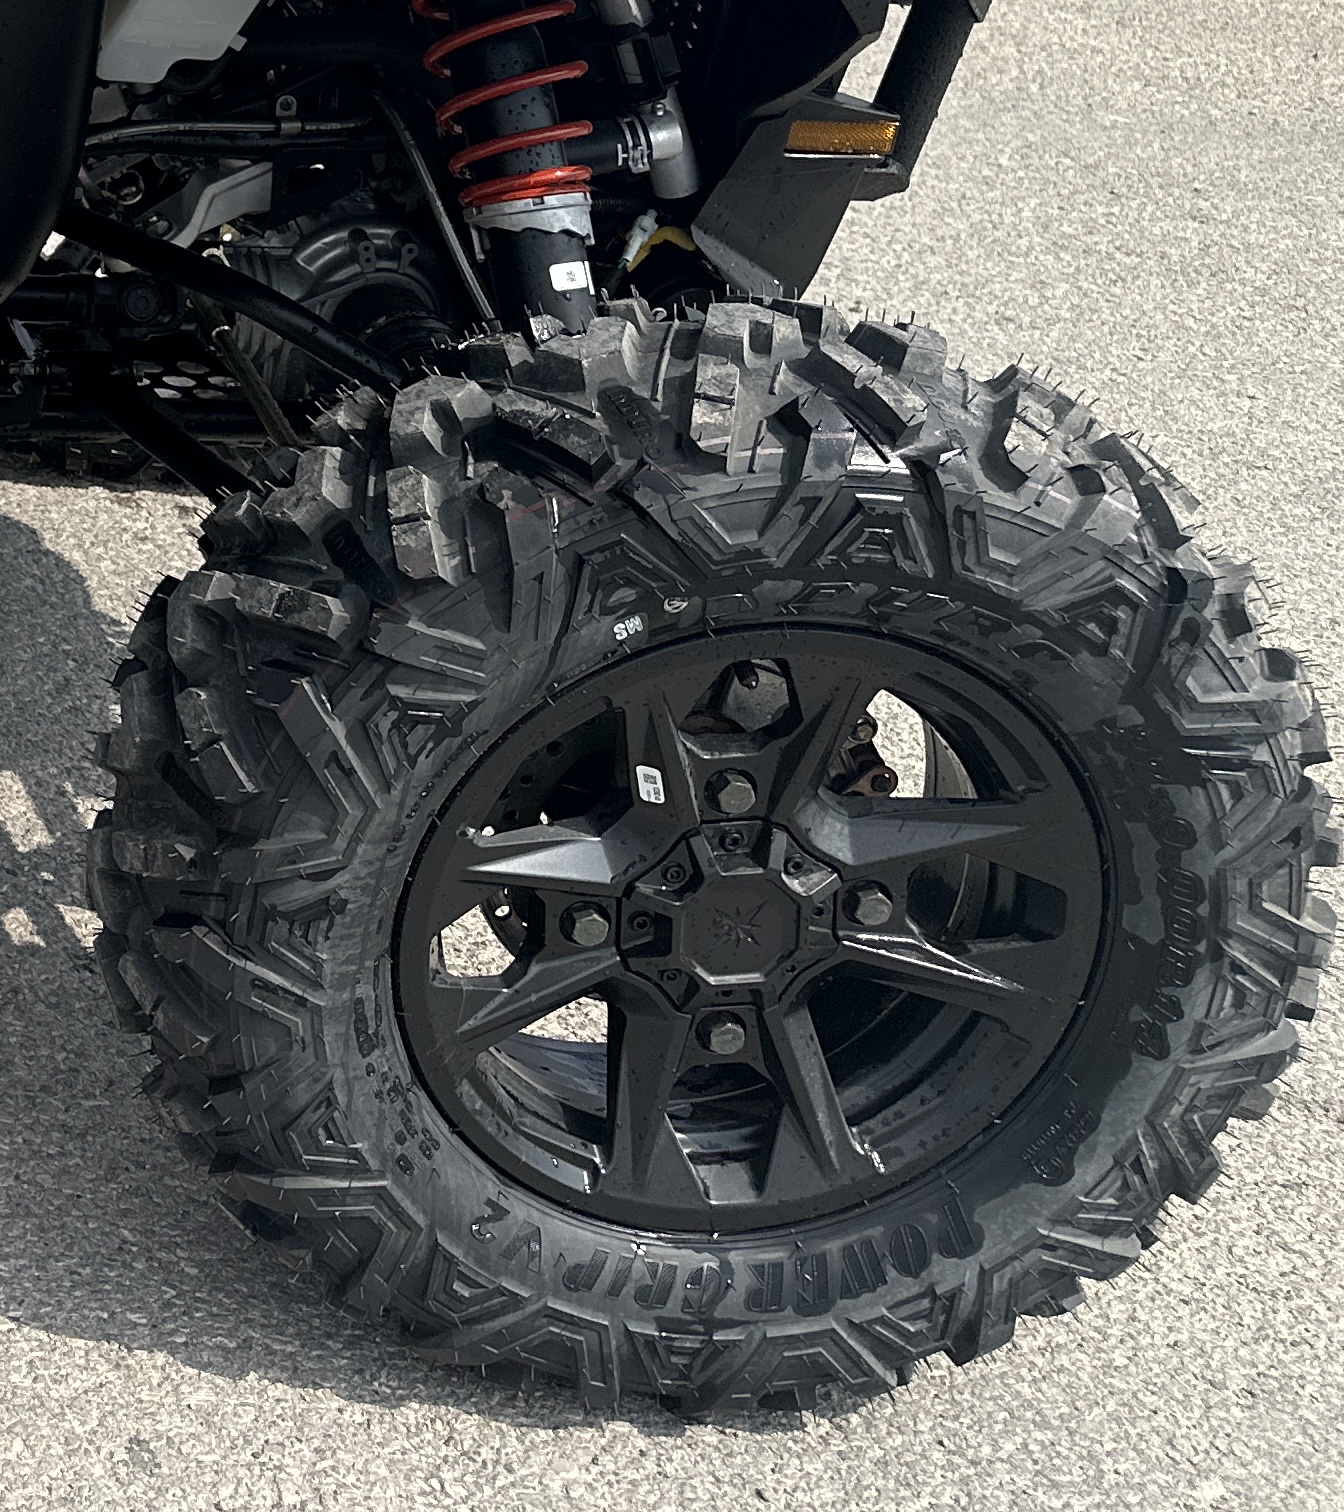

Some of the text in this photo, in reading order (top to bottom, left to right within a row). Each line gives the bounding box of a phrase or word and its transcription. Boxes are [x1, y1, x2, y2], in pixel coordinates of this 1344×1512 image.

[467, 1196, 978, 1316] POWER GRIP V2
